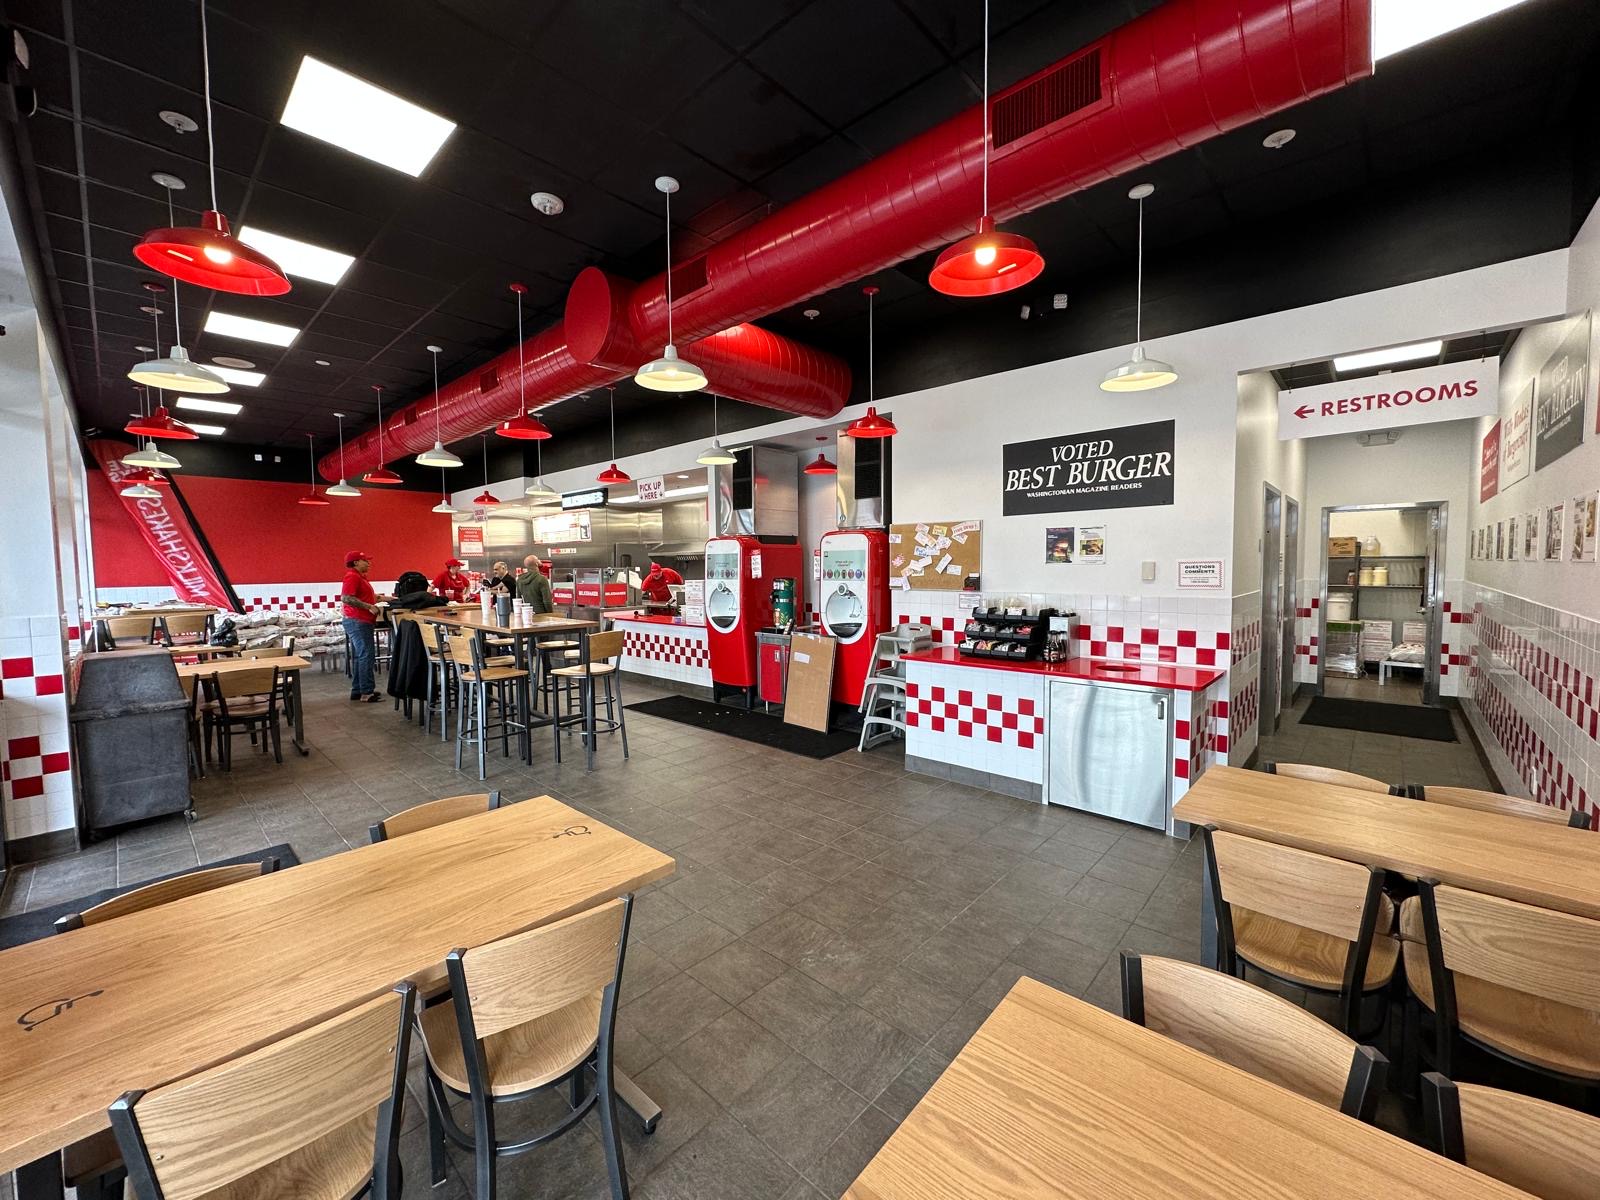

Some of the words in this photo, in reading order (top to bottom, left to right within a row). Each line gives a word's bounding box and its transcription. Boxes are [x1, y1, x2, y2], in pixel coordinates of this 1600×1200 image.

[1321, 379, 1479, 417] RESTROOMS
[1051, 439, 1114, 463] VOTED
[1005, 464, 1062, 492] BEST
[1066, 451, 1172, 486] BURGER
[639, 483, 652, 492] PICK
[653, 481, 662, 490] UP
[644, 491, 658, 500] HERE
[1026, 487, 1075, 498] WASHINGTONIAN
[1075, 485, 1110, 494] MAGAZINE
[1110, 482, 1143, 491] READERS
